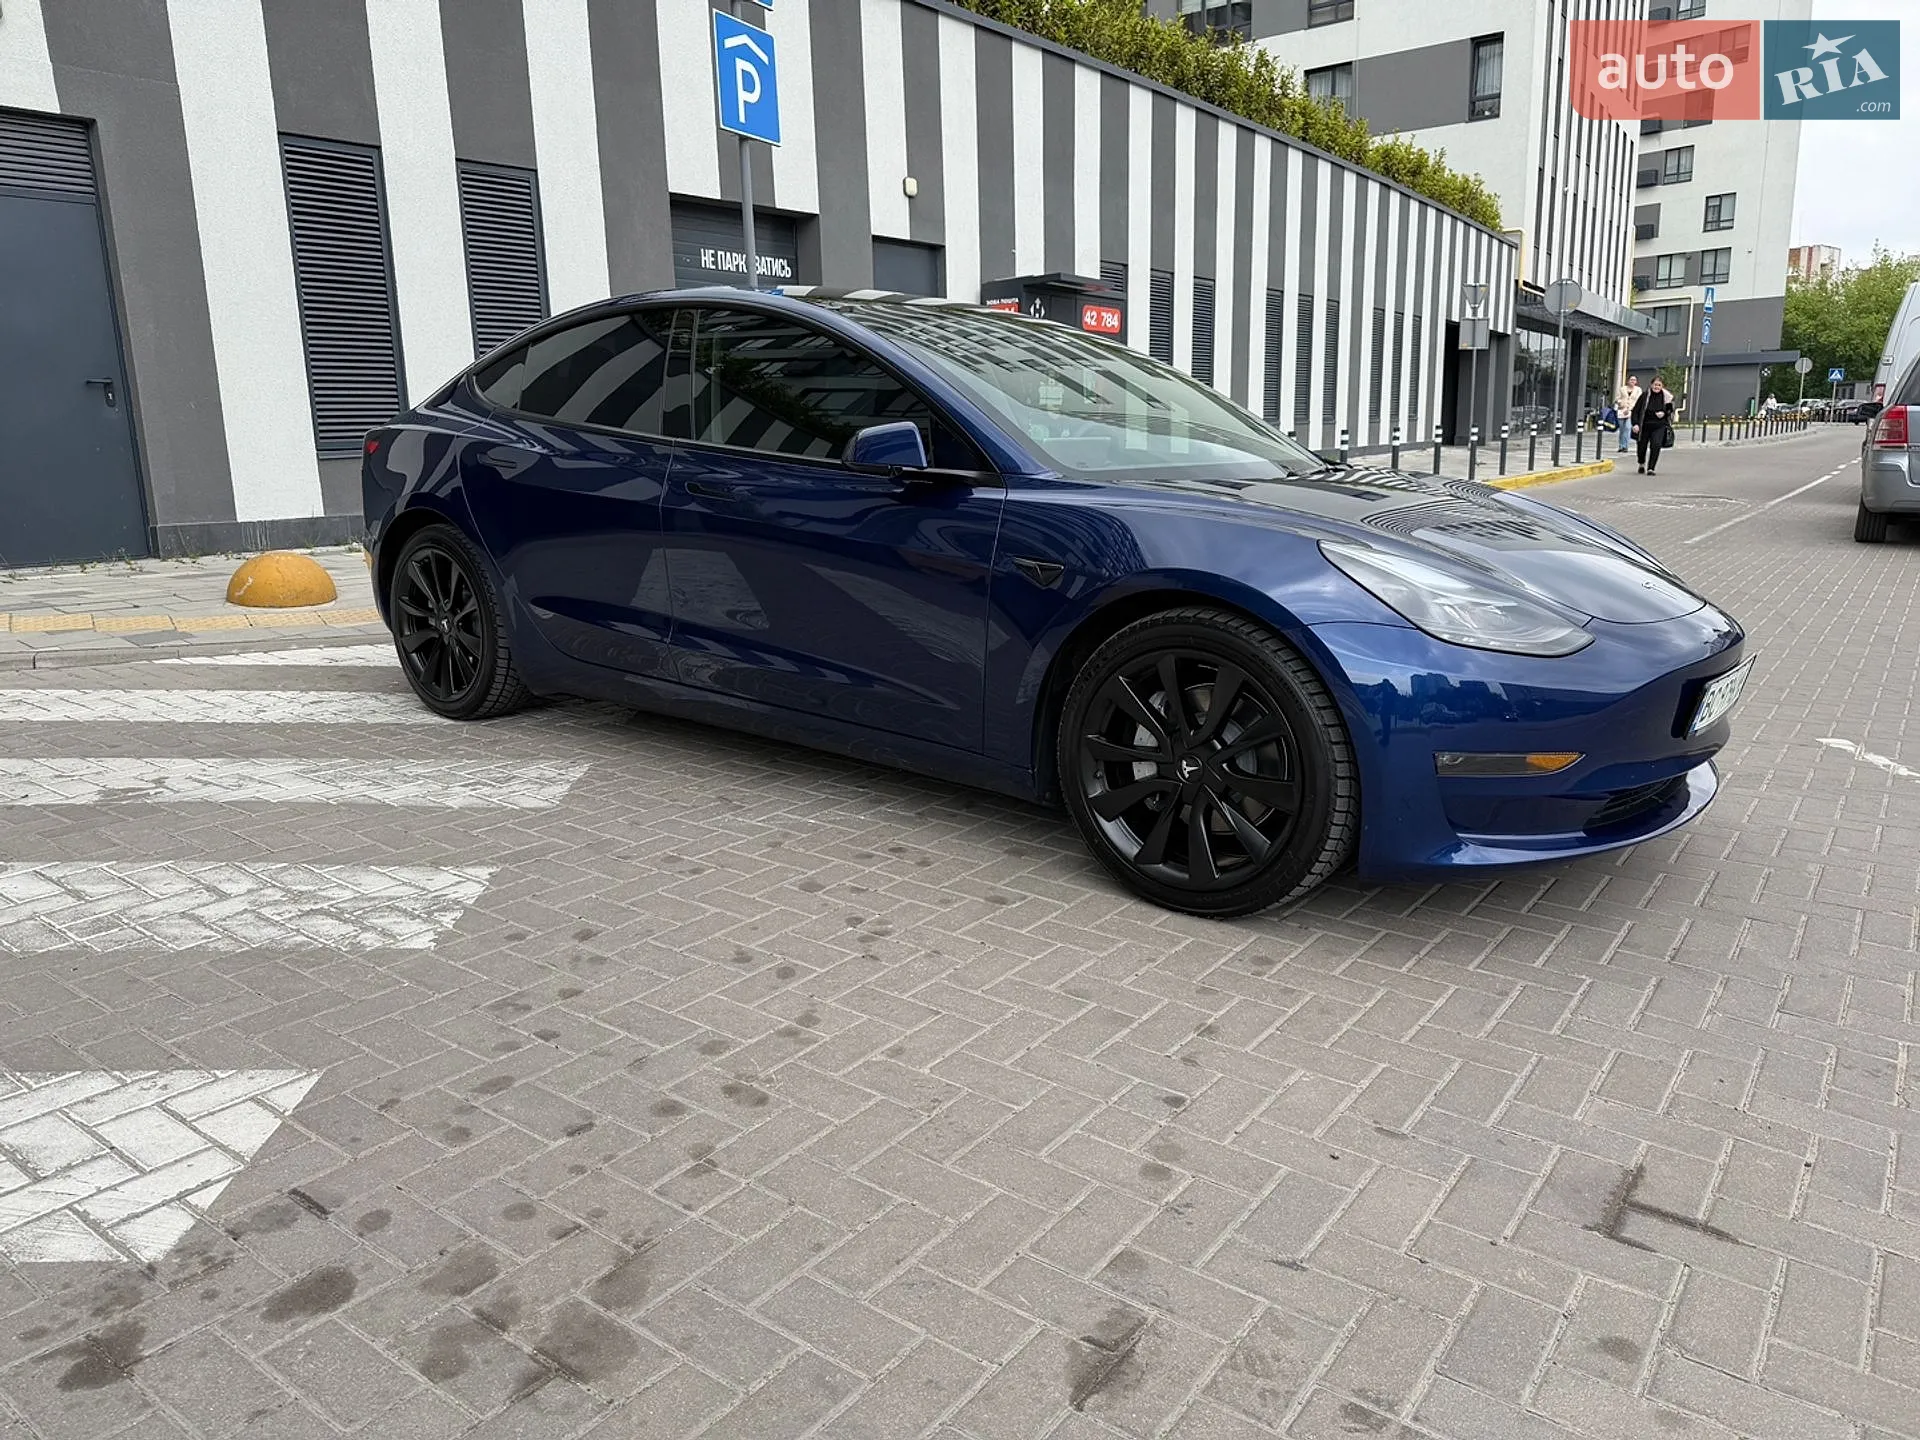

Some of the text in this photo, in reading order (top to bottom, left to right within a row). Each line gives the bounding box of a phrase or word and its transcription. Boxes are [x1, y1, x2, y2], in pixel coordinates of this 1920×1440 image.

[735, 57, 761, 124] P
[701, 248, 792, 278] НЕ ПАРКВАТИСЬ
[1084, 310, 1119, 329] 42 784
